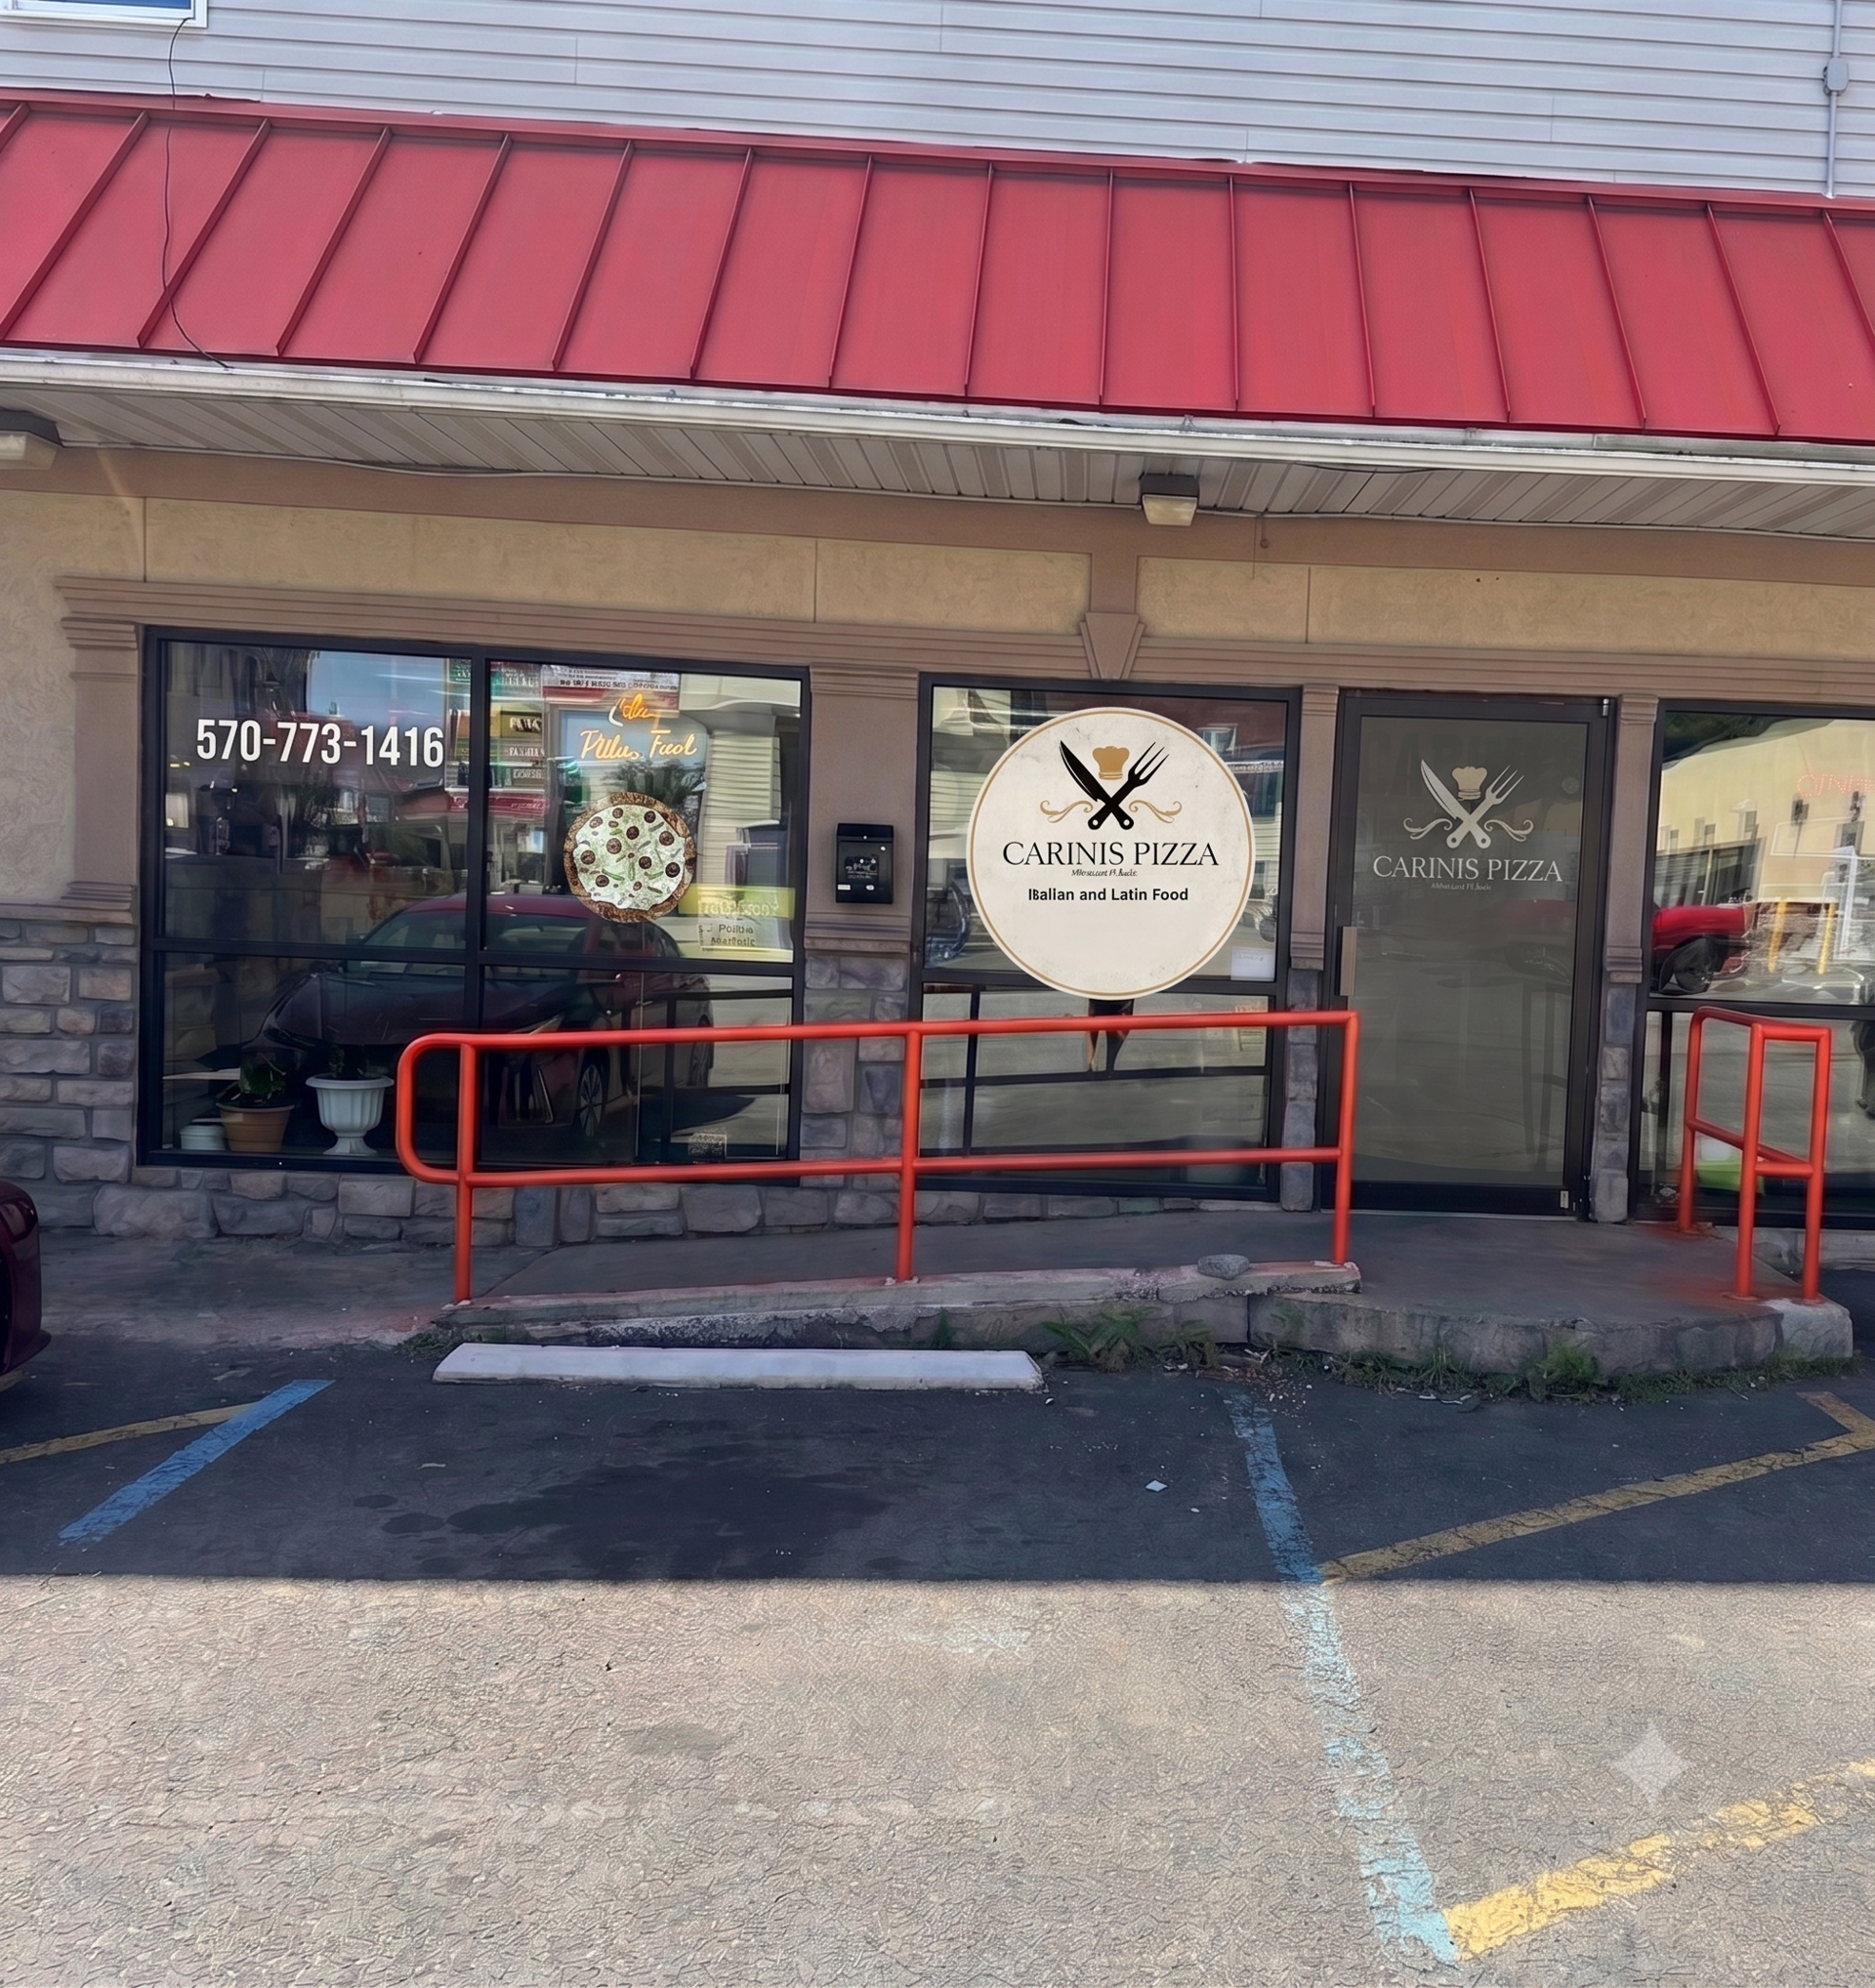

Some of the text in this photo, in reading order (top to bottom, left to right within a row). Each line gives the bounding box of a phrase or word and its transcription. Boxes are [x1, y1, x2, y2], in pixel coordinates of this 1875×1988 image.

[196, 719, 444, 767] 570-773-1416
[1002, 841, 1220, 866] CARINIS PIZZA
[1373, 855, 1563, 883] CARINIS PIZZA
[1079, 888, 1106, 901] and
[1111, 888, 1147, 901] Latin
[1152, 888, 1189, 901] Food
